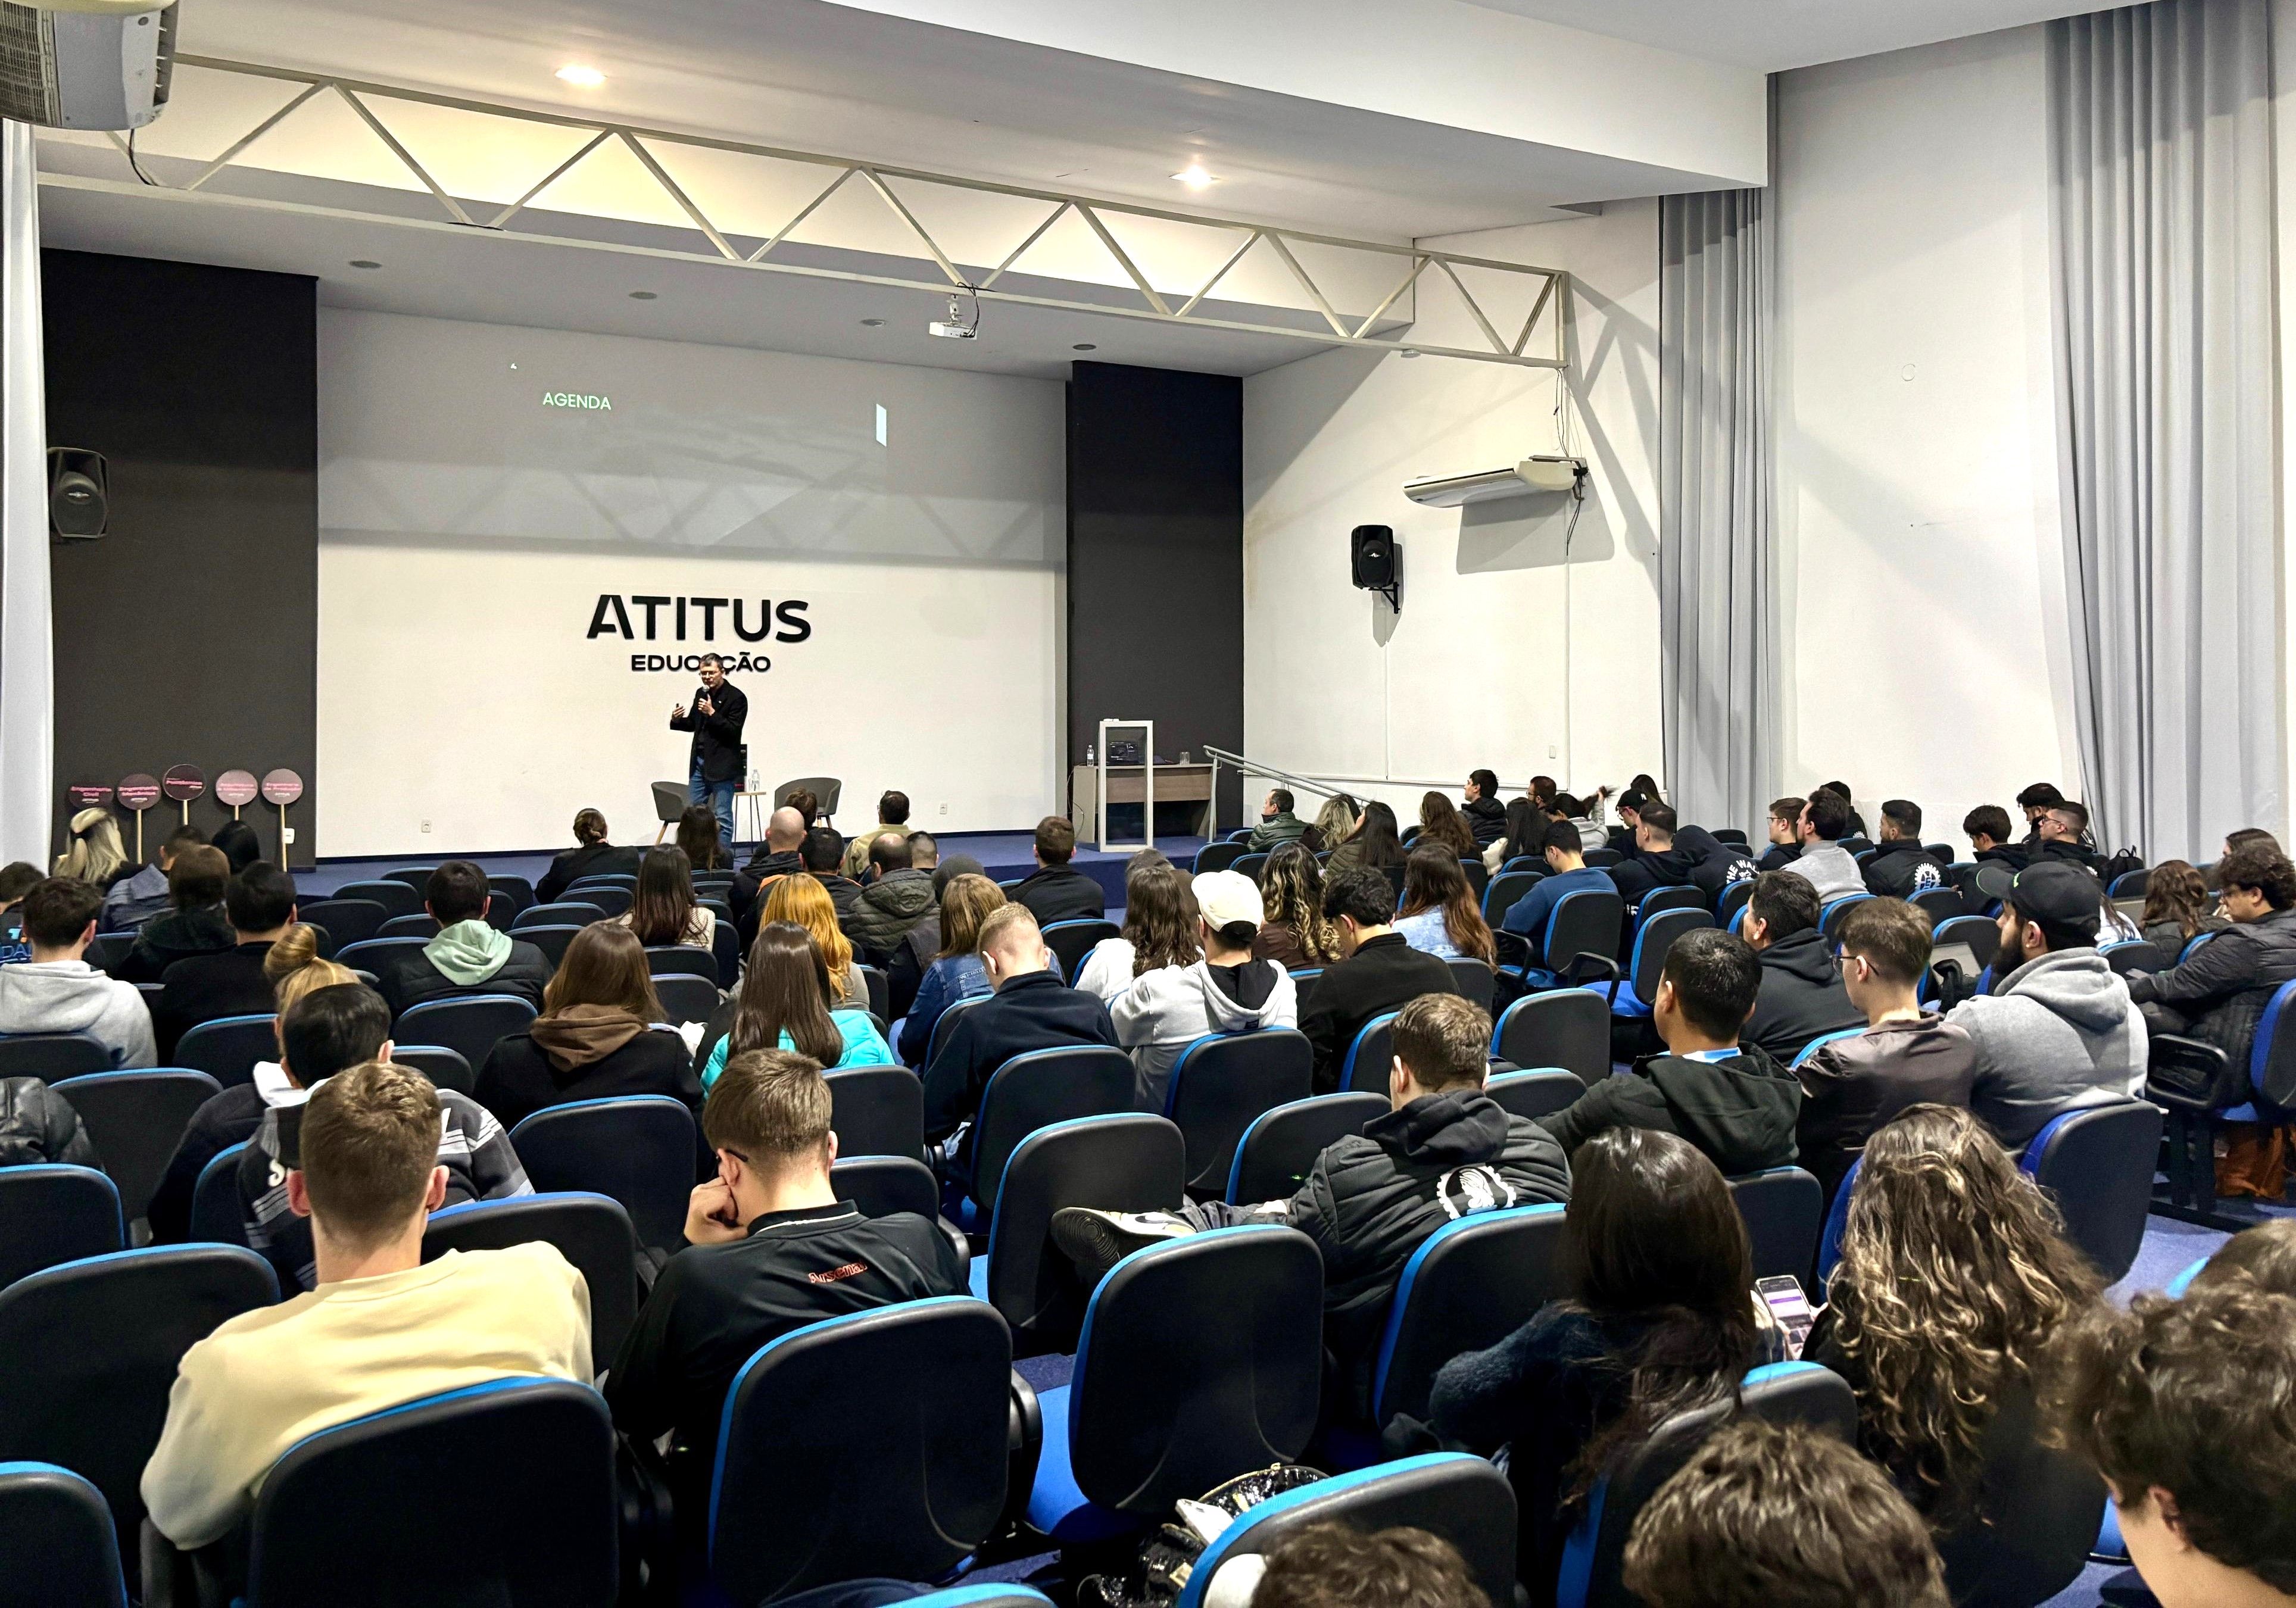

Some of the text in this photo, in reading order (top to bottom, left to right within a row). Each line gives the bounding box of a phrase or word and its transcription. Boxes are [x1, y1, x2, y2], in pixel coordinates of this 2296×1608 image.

[542, 392, 612, 410] AGENDA
[587, 594, 811, 643] ATITUS
[631, 651, 771, 675] EDUCÇÃO
